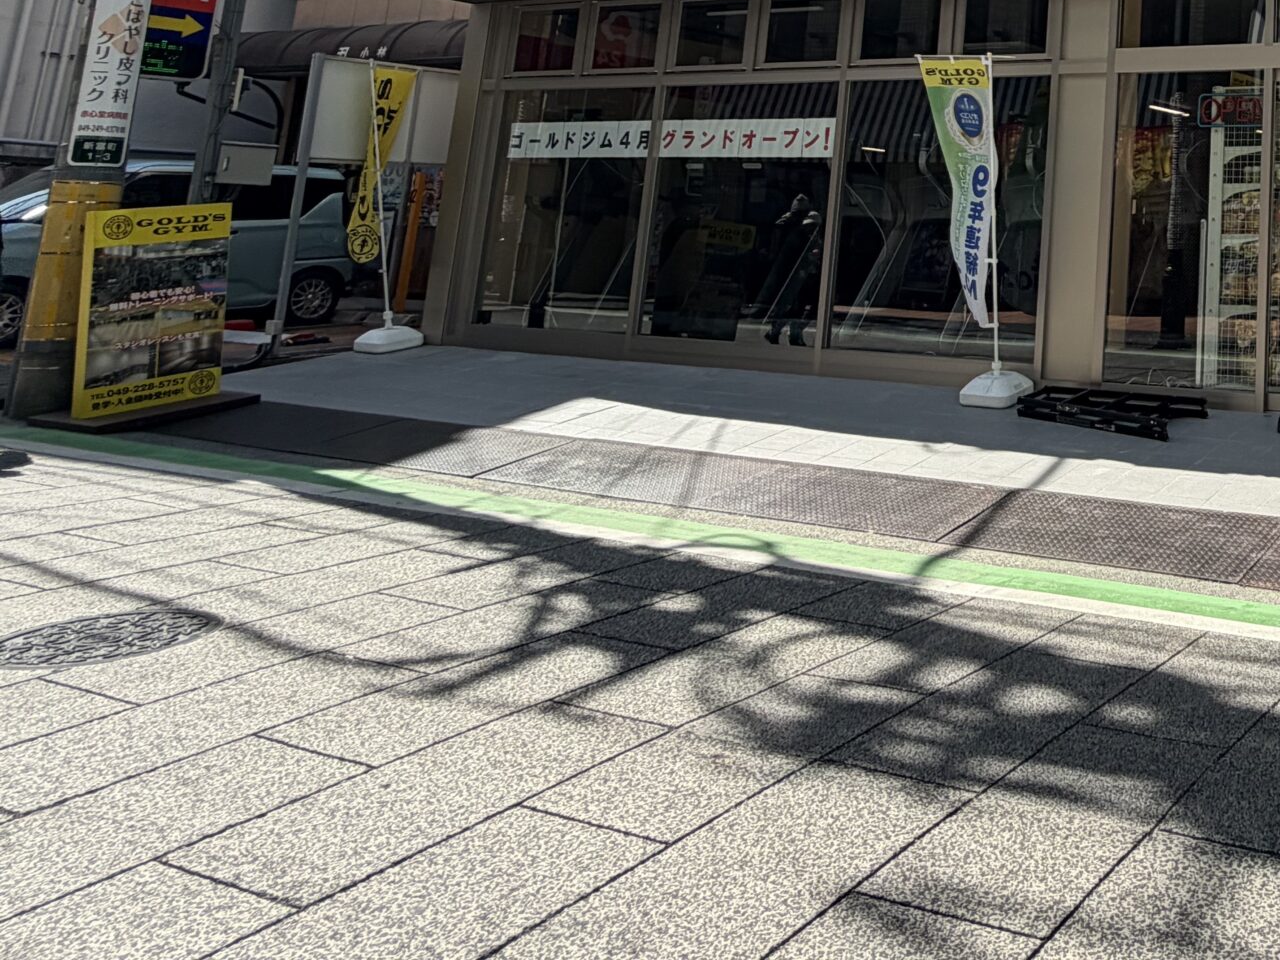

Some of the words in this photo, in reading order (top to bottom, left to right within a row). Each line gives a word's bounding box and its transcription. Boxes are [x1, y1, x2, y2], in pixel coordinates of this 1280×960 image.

[86, 30, 116, 103] クリニック
[510, 129, 650, 151] ゴールドジム4月
[661, 127, 832, 152] グランドオープン!
[136, 212, 226, 228] GOLD'S
[152, 222, 211, 236] GYM
